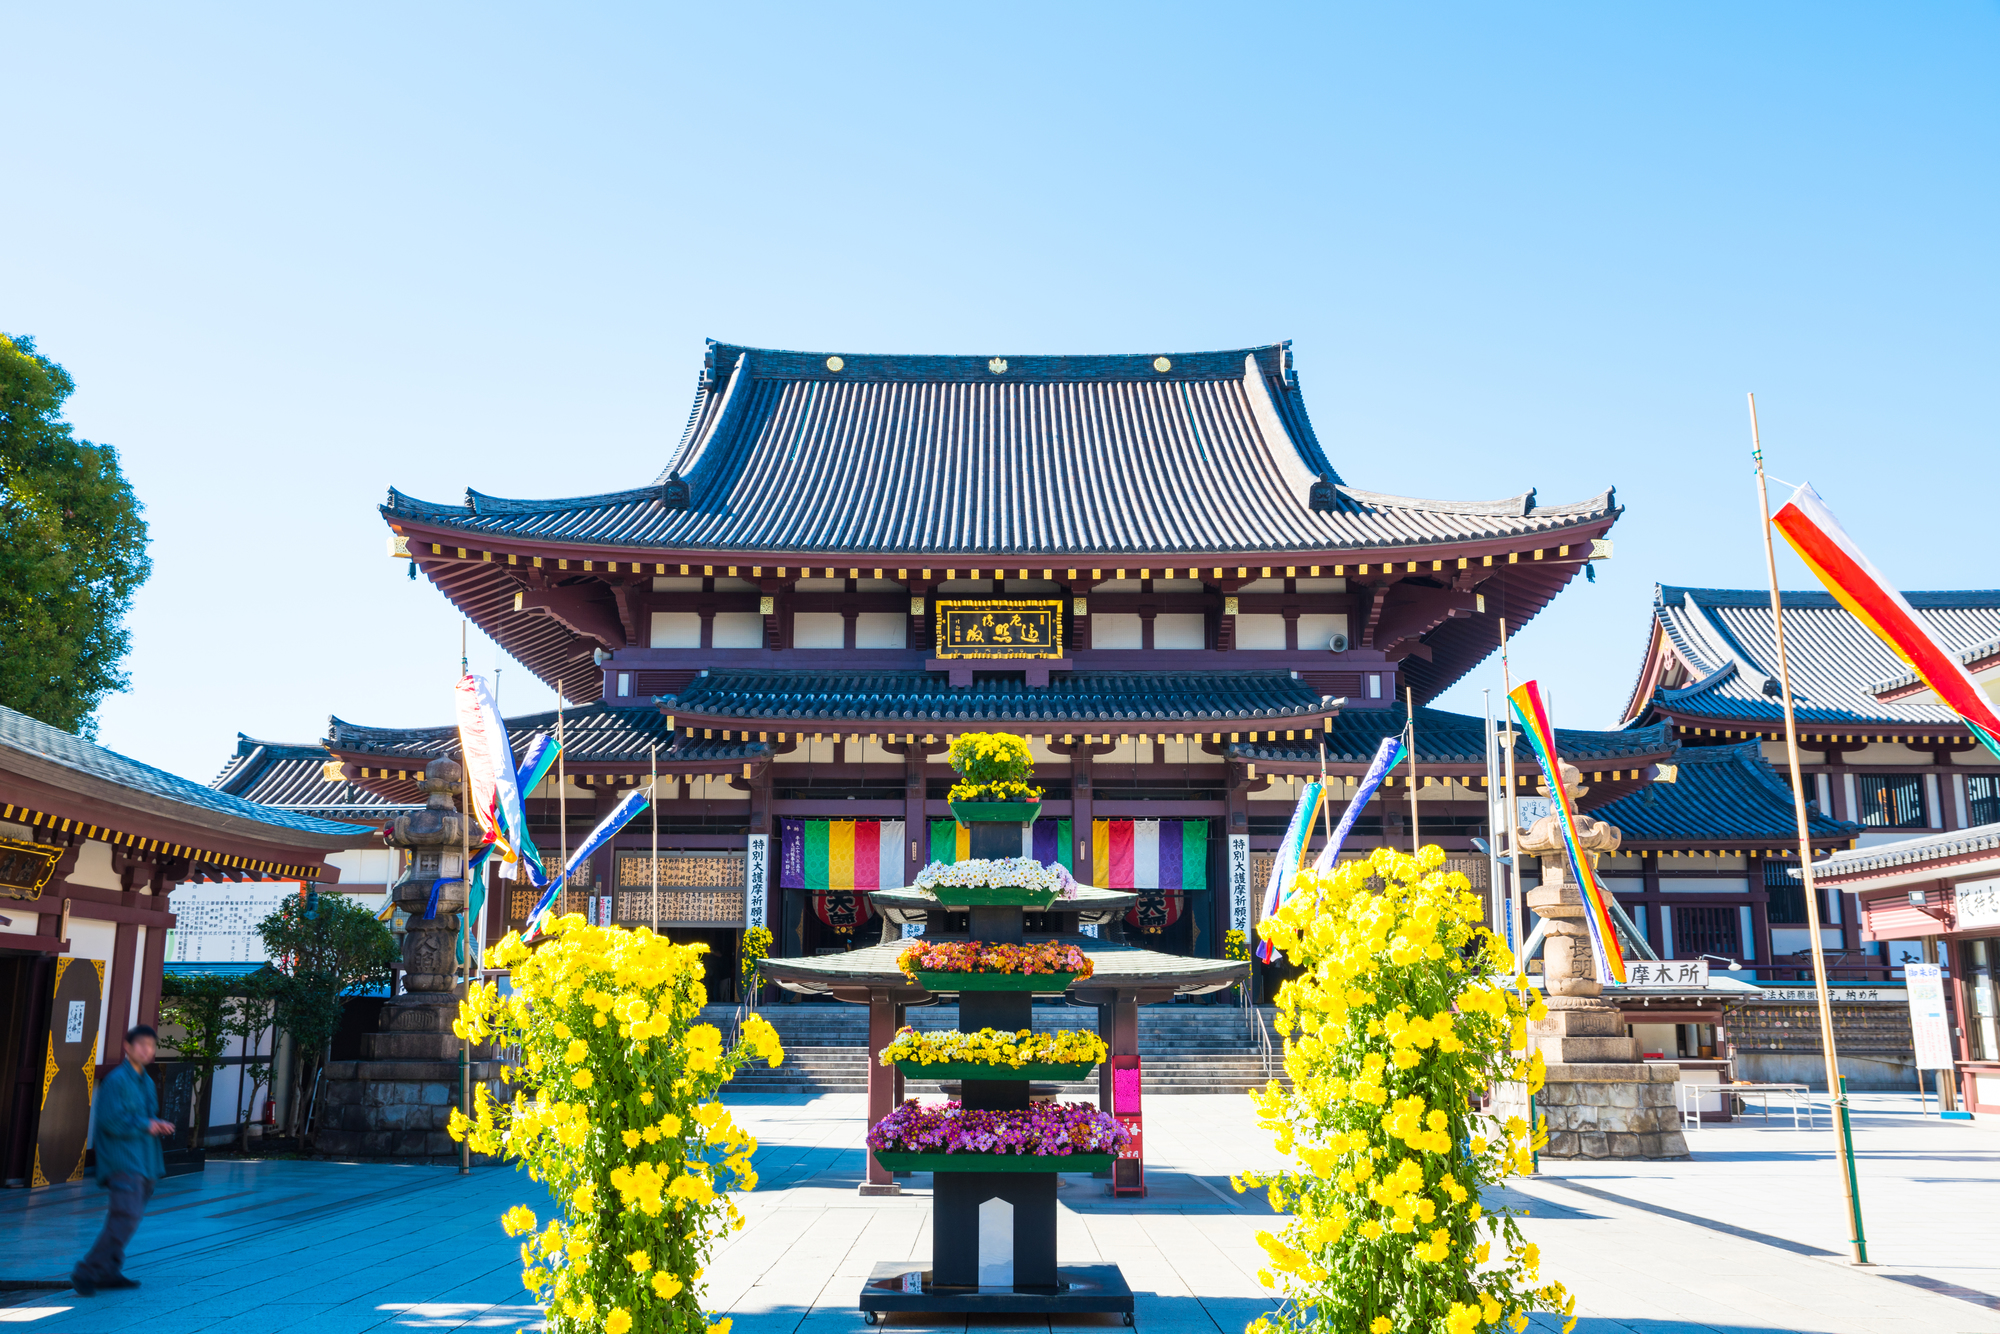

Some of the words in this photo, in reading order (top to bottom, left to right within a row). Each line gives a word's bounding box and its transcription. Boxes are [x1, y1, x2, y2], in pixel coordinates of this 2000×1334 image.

[1232, 839, 1246, 932] 特別大護摩祈願芳
[824, 890, 859, 925] 大師
[1569, 937, 1592, 976] 長明
[1908, 967, 1938, 978] 御朱印
[1622, 964, 1700, 985] 摩木所
